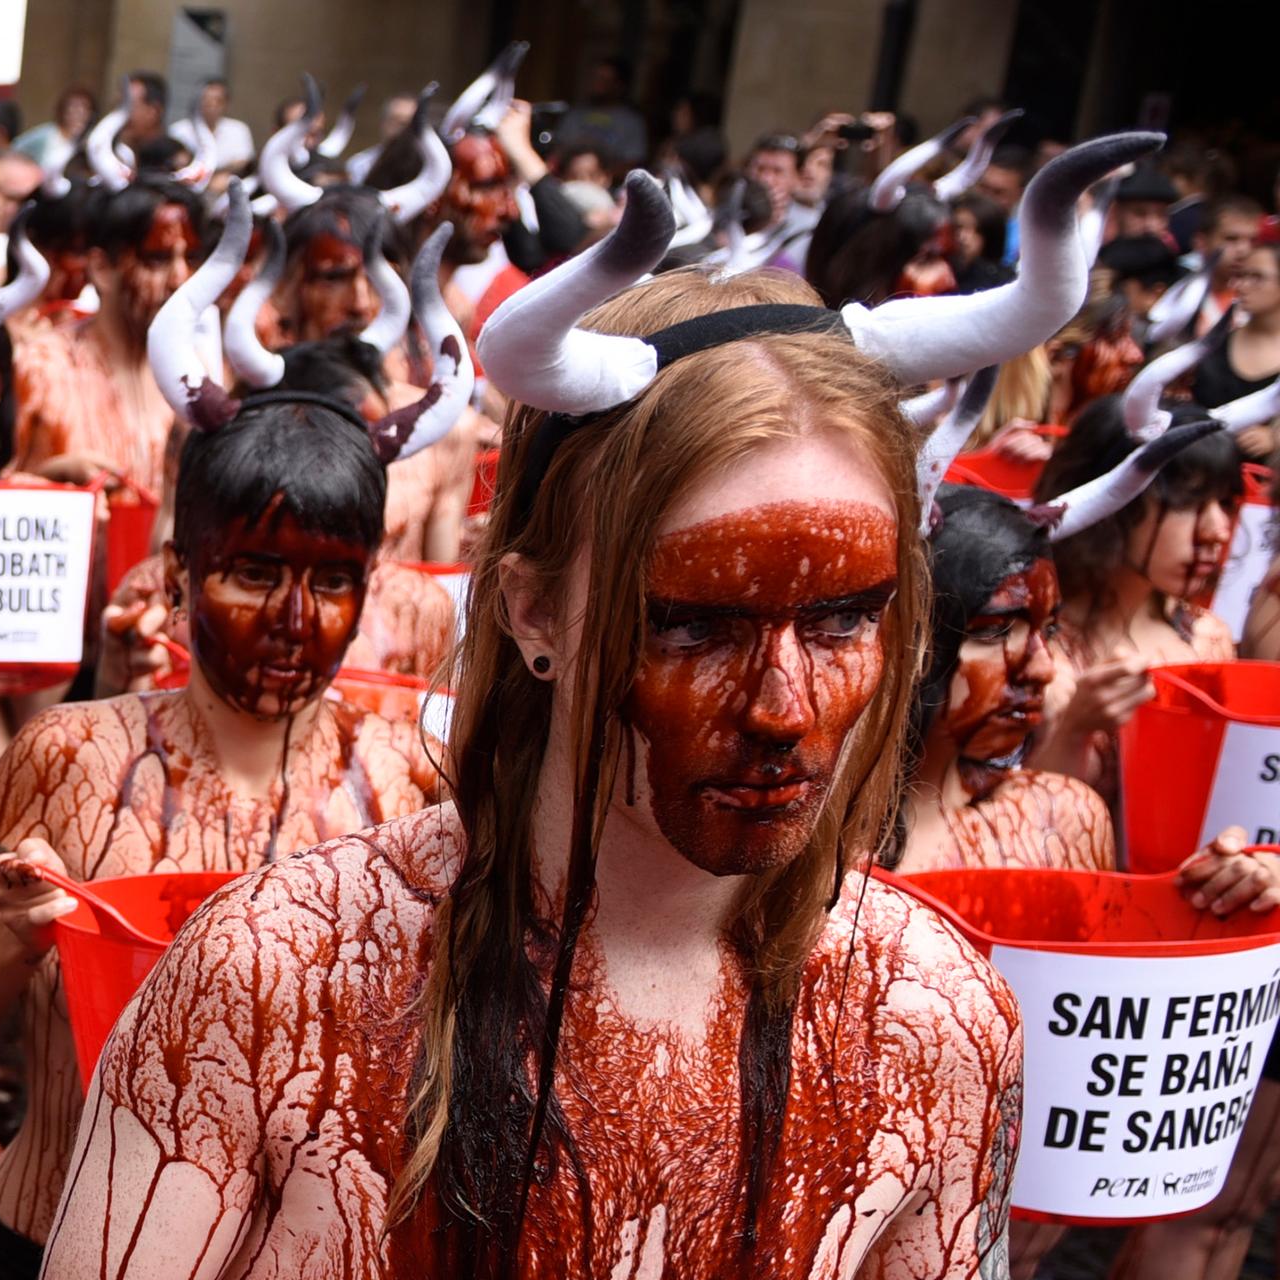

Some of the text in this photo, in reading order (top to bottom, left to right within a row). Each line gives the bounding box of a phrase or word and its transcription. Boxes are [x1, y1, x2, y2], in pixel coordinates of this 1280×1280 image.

[1048, 992, 1151, 1040] SAN
[1086, 1034, 1254, 1097] SE BAÑA
[1043, 1088, 1253, 1154] DE SANGRE
